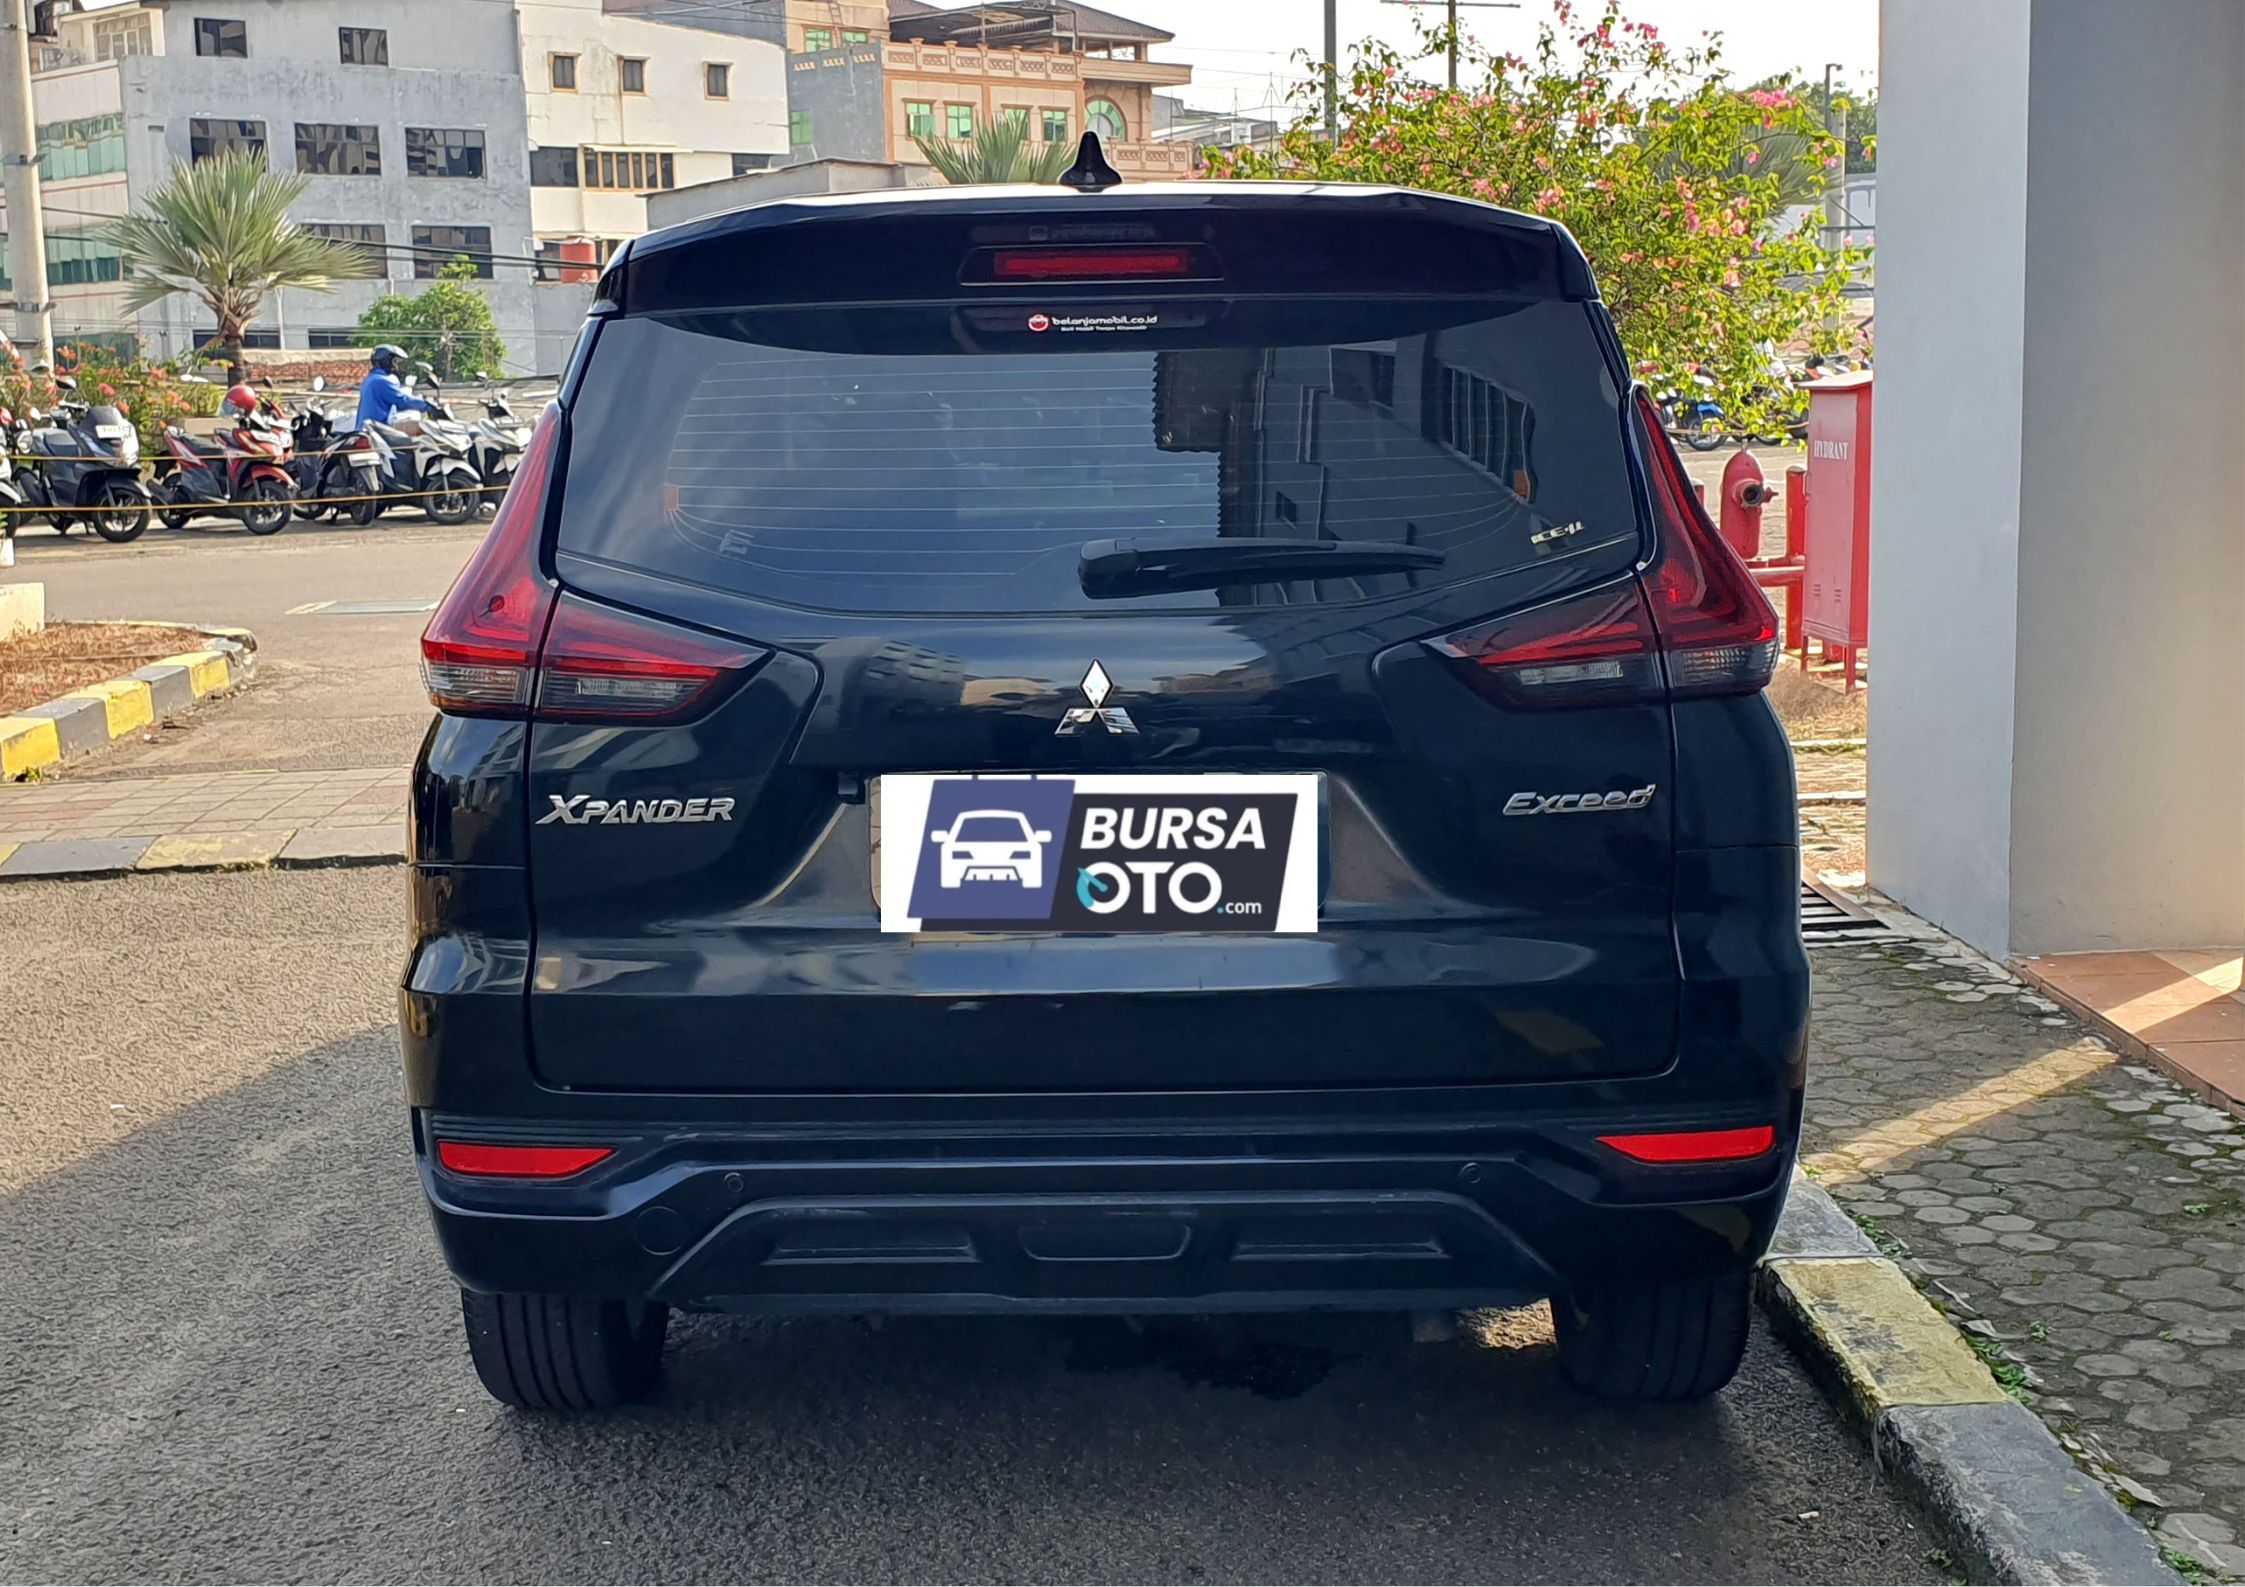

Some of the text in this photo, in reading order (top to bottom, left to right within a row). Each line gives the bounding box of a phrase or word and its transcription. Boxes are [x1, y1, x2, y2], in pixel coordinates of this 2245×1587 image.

[1051, 315, 1158, 327] belanjamobil.co.id
[1813, 440, 1849, 460] HYDRANT
[535, 794, 735, 825] XPANDER
[1502, 783, 1656, 816] Exceed
